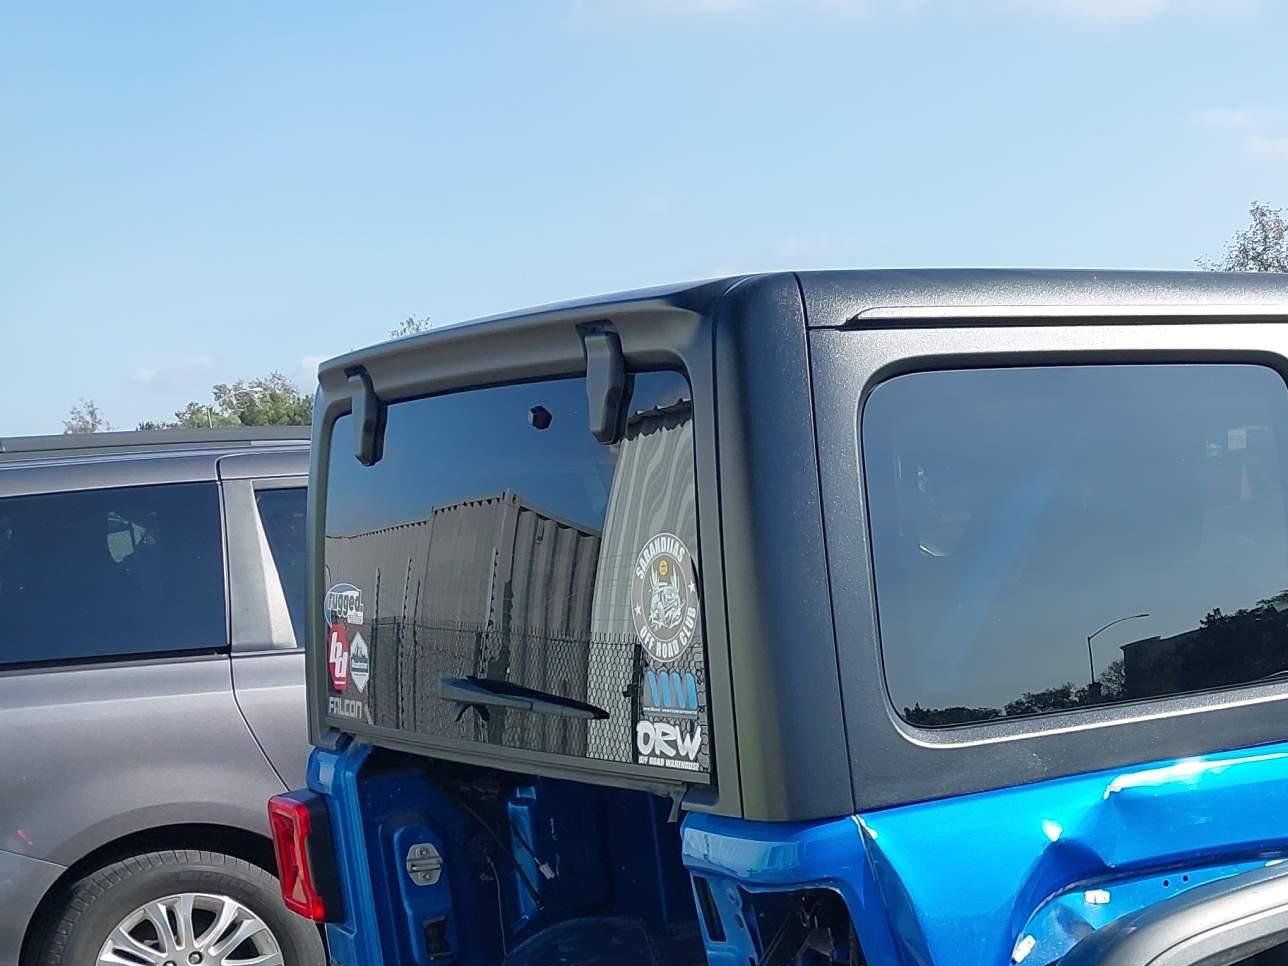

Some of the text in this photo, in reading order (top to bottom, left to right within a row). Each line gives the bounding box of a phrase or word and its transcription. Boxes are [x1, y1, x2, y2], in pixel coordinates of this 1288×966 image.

[328, 592, 361, 617] rugged
[640, 607, 697, 659] OFF ROAD CLUB
[328, 696, 362, 719] FALCON
